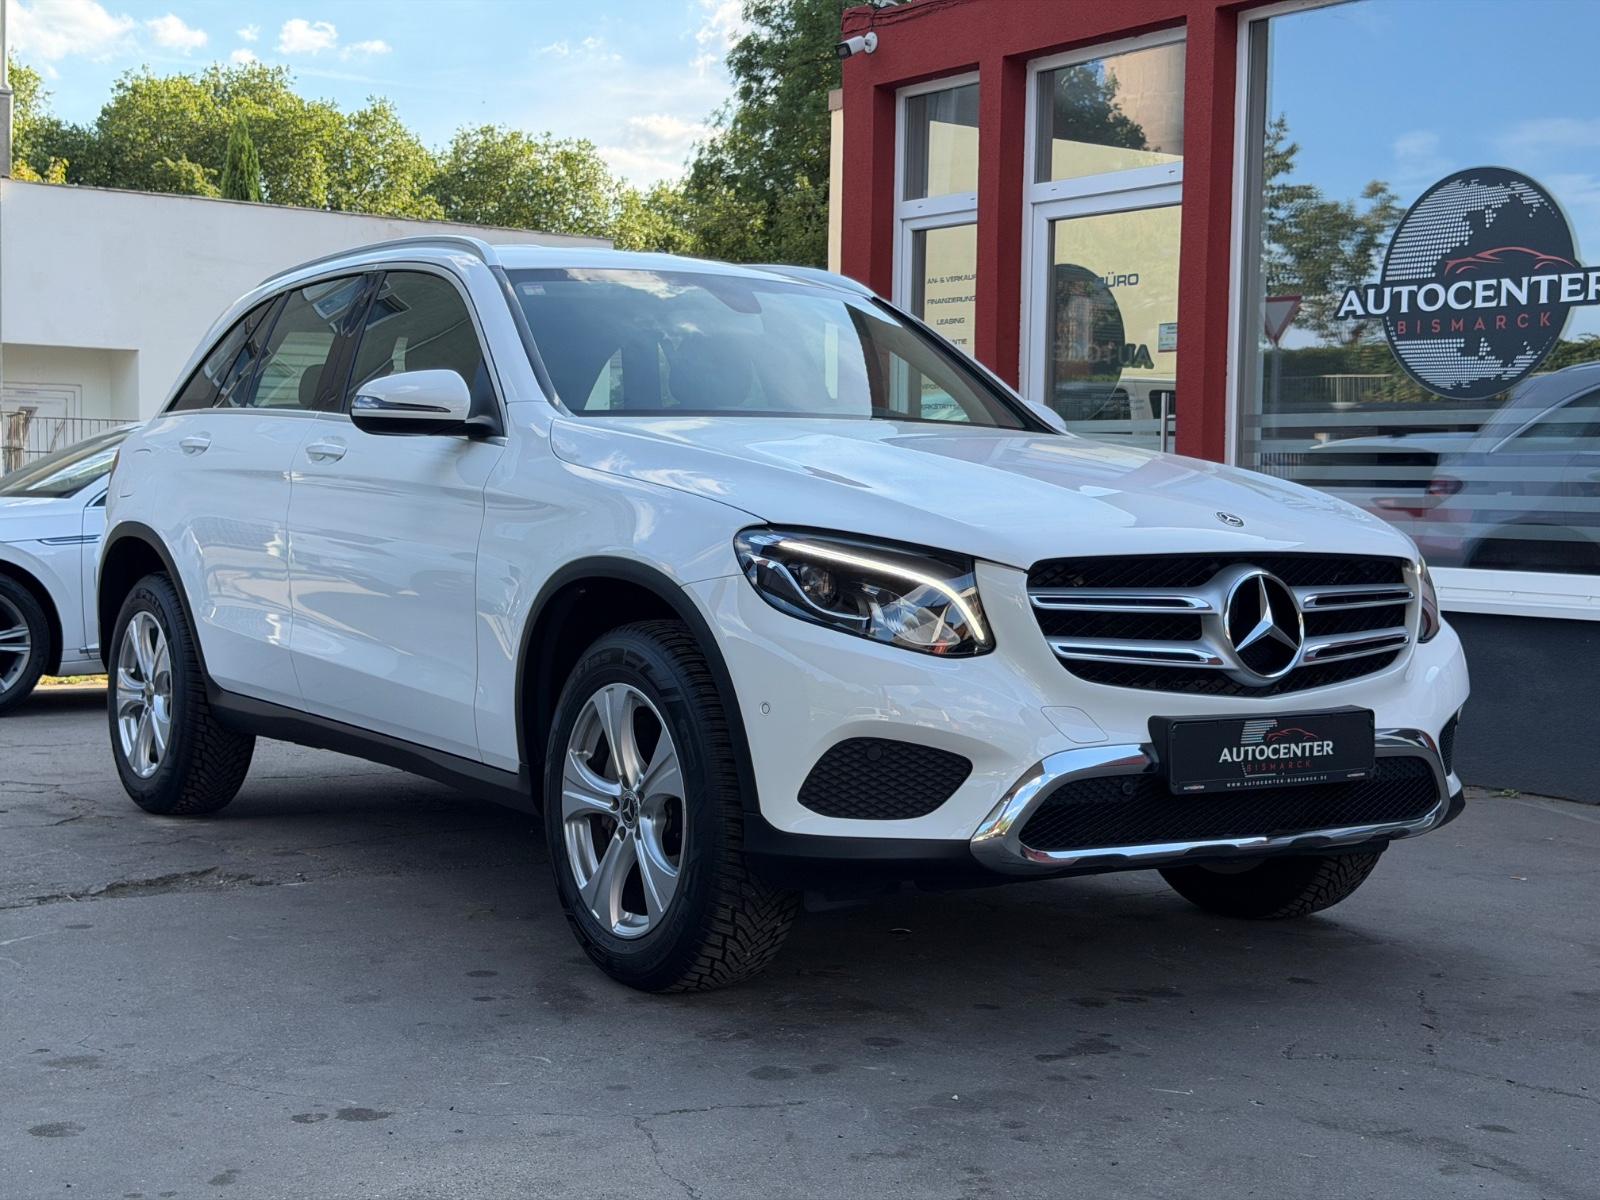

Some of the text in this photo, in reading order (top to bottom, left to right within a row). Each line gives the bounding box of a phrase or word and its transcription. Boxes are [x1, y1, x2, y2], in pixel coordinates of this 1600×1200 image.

[936, 317, 965, 325] LEASING
[1397, 311, 1551, 335] BISMARCK
[1218, 740, 1334, 763] AUTOCENTER
[1246, 760, 1313, 773] BISMARCK
